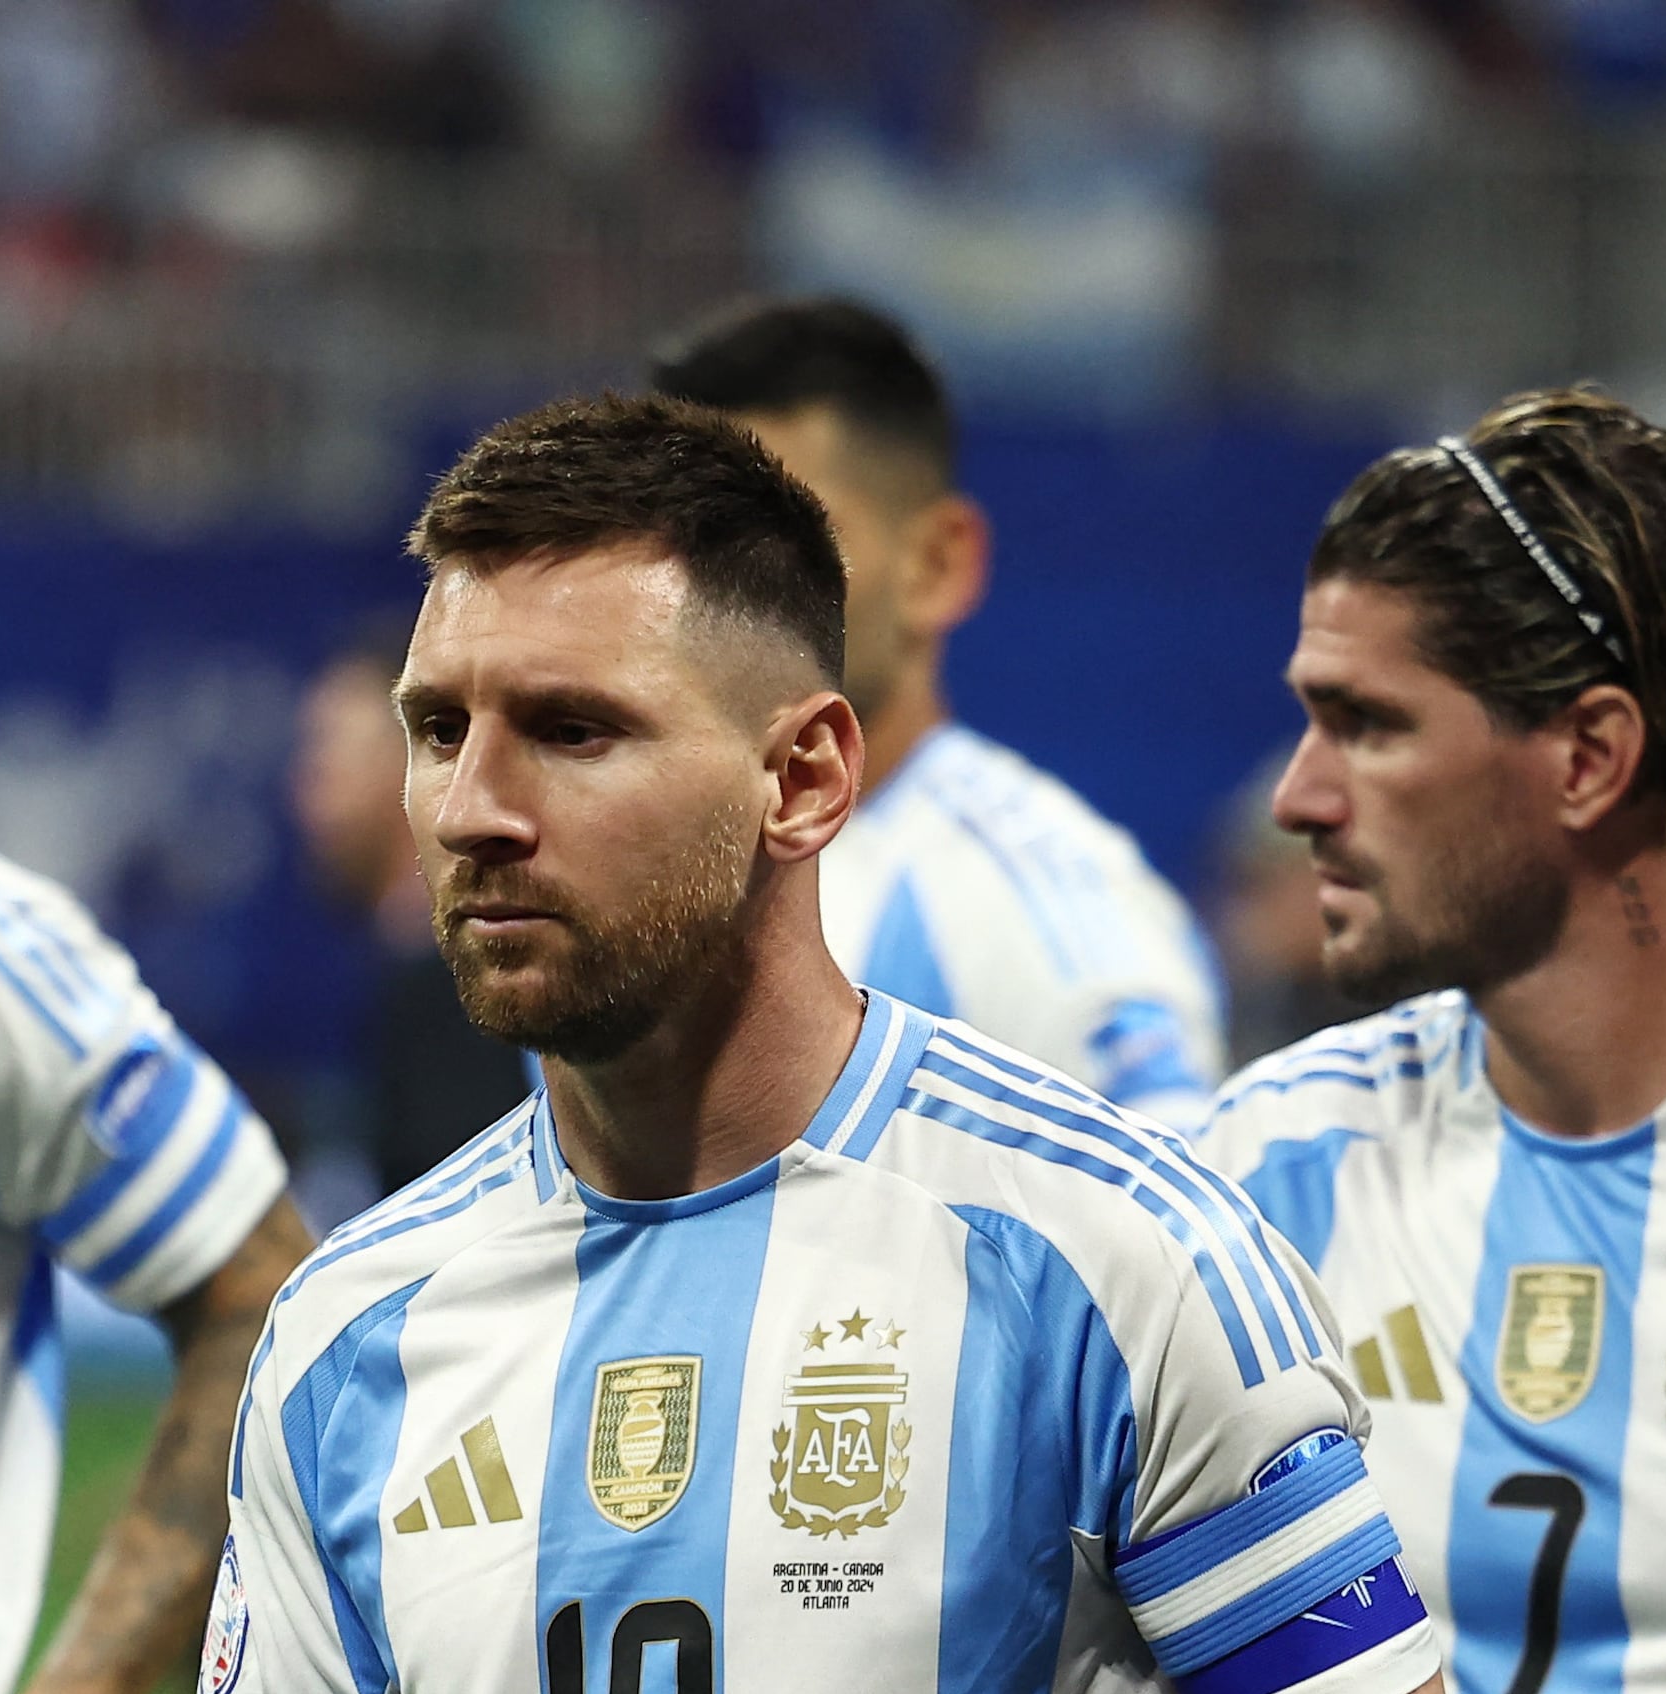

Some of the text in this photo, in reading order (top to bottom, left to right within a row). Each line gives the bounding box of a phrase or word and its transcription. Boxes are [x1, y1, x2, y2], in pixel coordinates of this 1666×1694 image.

[797, 1408, 880, 1488] AFA
[773, 1562, 828, 1576] ARGENTINA
[842, 1562, 884, 1576] CANADA
[780, 1579, 874, 1593] 20 DE JUNIO 2024
[803, 1596, 849, 1609] ATLANTA
